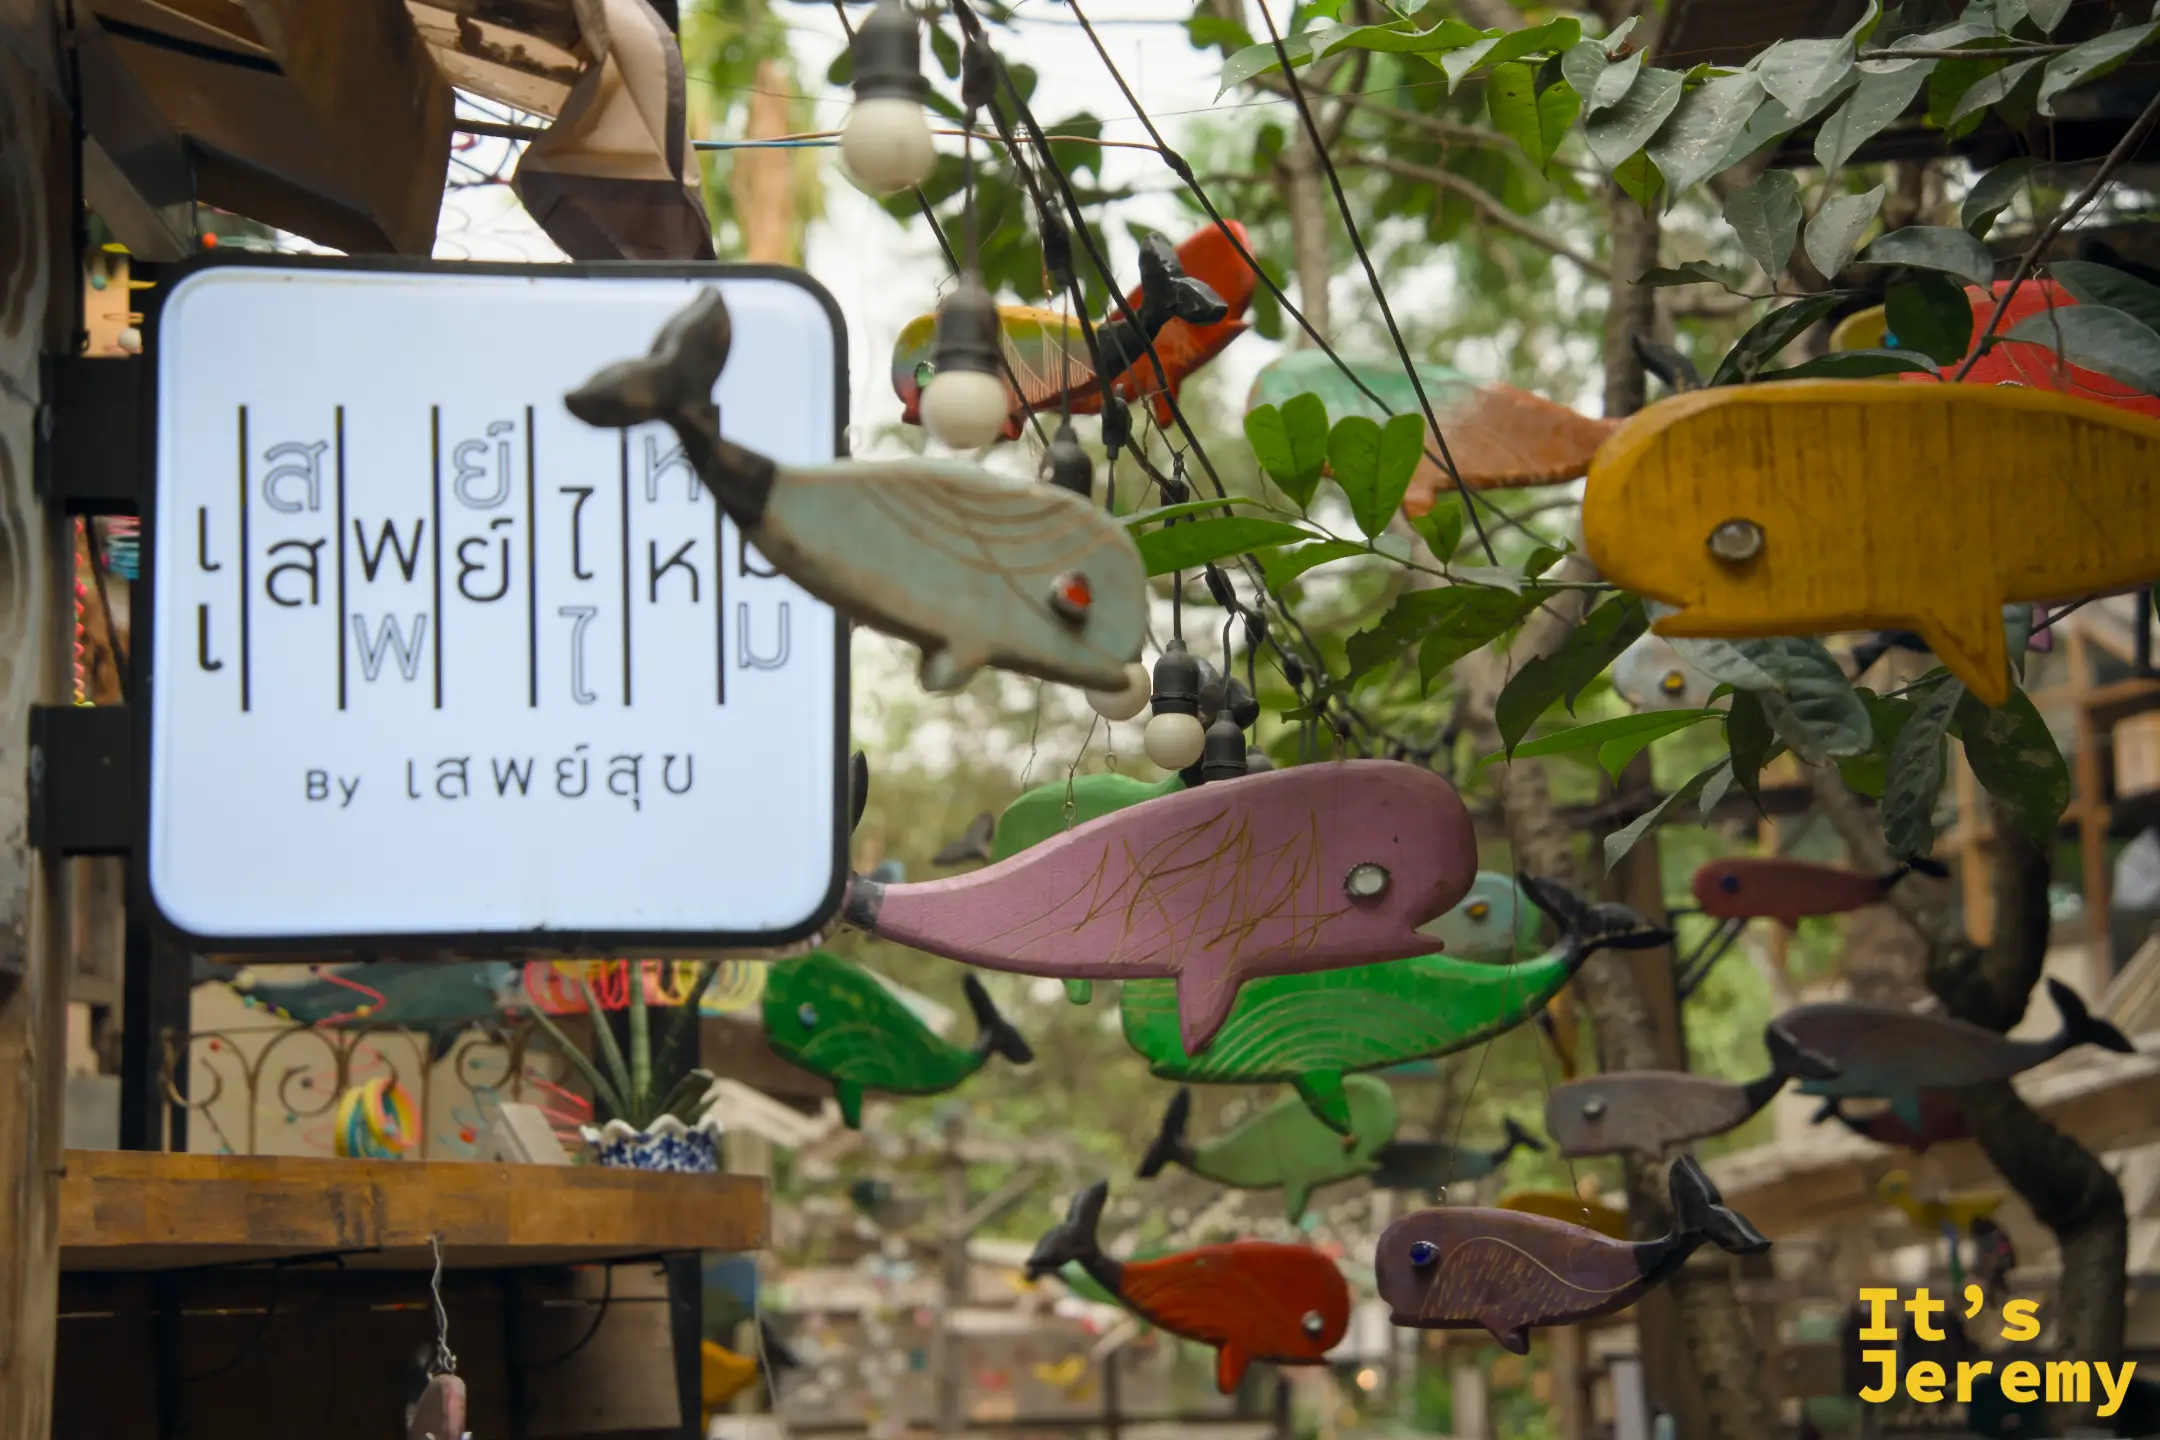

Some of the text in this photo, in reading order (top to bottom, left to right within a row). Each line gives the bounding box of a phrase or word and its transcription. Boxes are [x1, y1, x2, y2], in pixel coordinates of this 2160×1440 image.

[306, 744, 693, 812] By เสพย์สุข
